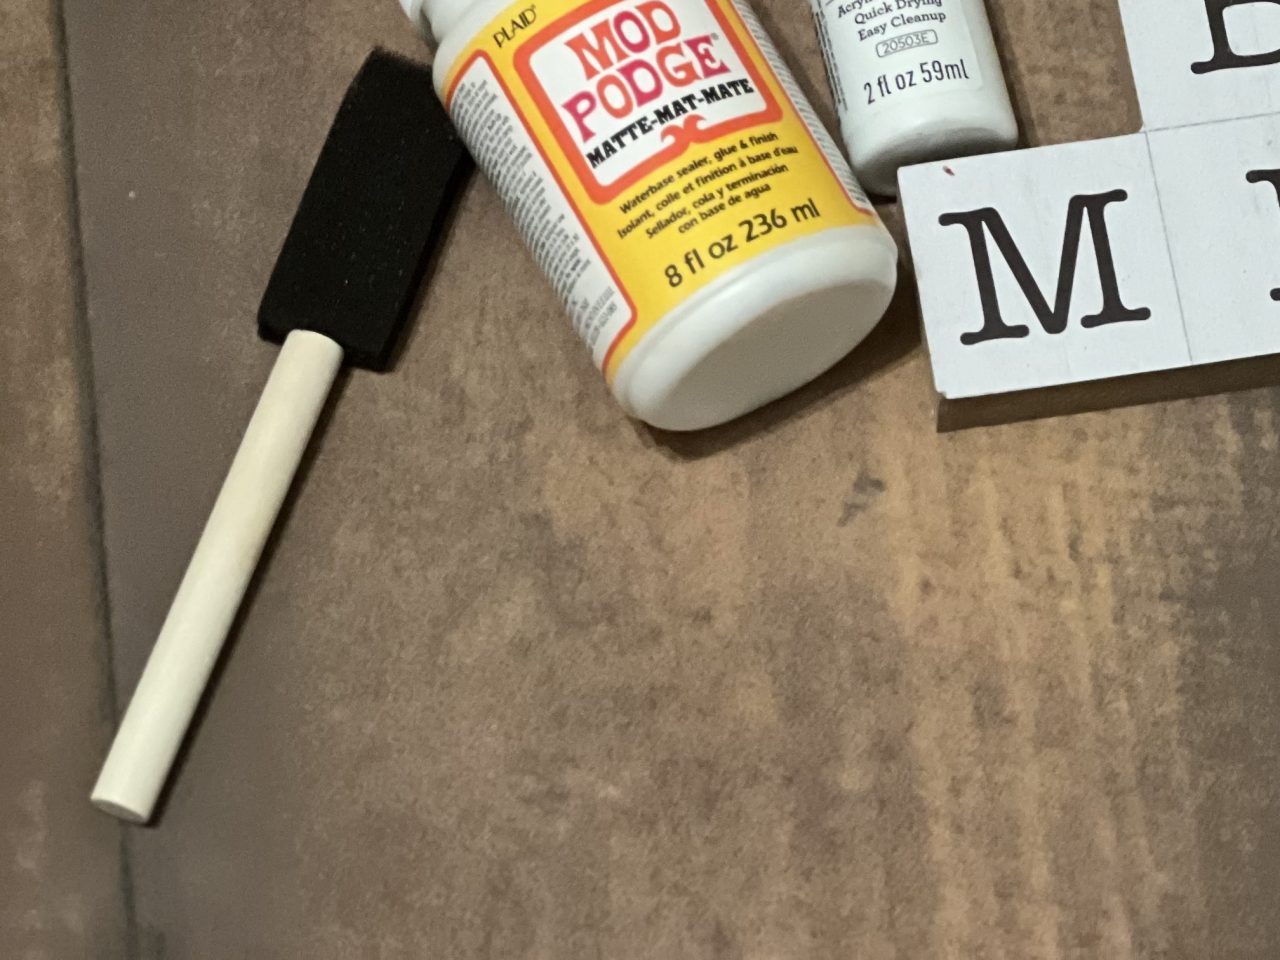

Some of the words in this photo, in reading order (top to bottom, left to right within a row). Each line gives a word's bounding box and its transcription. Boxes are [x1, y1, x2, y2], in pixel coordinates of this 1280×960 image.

[492, 7, 538, 48] PLAID
[564, 0, 682, 81] MOD
[854, 1, 893, 26] Quick
[858, 23, 888, 42] Easy
[890, 11, 947, 28] Cleanup
[882, 31, 931, 56] 20503E
[561, 34, 732, 144] PODGE
[863, 81, 876, 106] 2
[877, 73, 892, 98] fl
[895, 70, 917, 91] oz
[919, 58, 970, 84] 59ml
[584, 77, 755, 170] MATTE-MAT-MATE
[617, 208, 655, 240] Isolant,
[655, 191, 681, 212] colle
[682, 182, 695, 195] et
[695, 162, 737, 188] finition
[748, 151, 772, 164] base
[773, 144, 799, 158] d'eau
[619, 173, 676, 214] Waterbase
[676, 155, 712, 179] sealer,
[713, 145, 738, 162] glue
[739, 139, 749, 150] &
[749, 132, 778, 147] finish
[645, 206, 692, 240] Sellador,
[692, 192, 716, 210] cola
[716, 187, 725, 199] y
[725, 163, 789, 191] terminación
[677, 217, 699, 235] con
[700, 202, 726, 222] base
[727, 194, 742, 207] de
[744, 183, 772, 200] agua
[663, 263, 684, 288] 8
[684, 248, 706, 275] fl
[708, 233, 740, 260] oz
[737, 208, 788, 243] 236
[790, 197, 822, 223] ml
